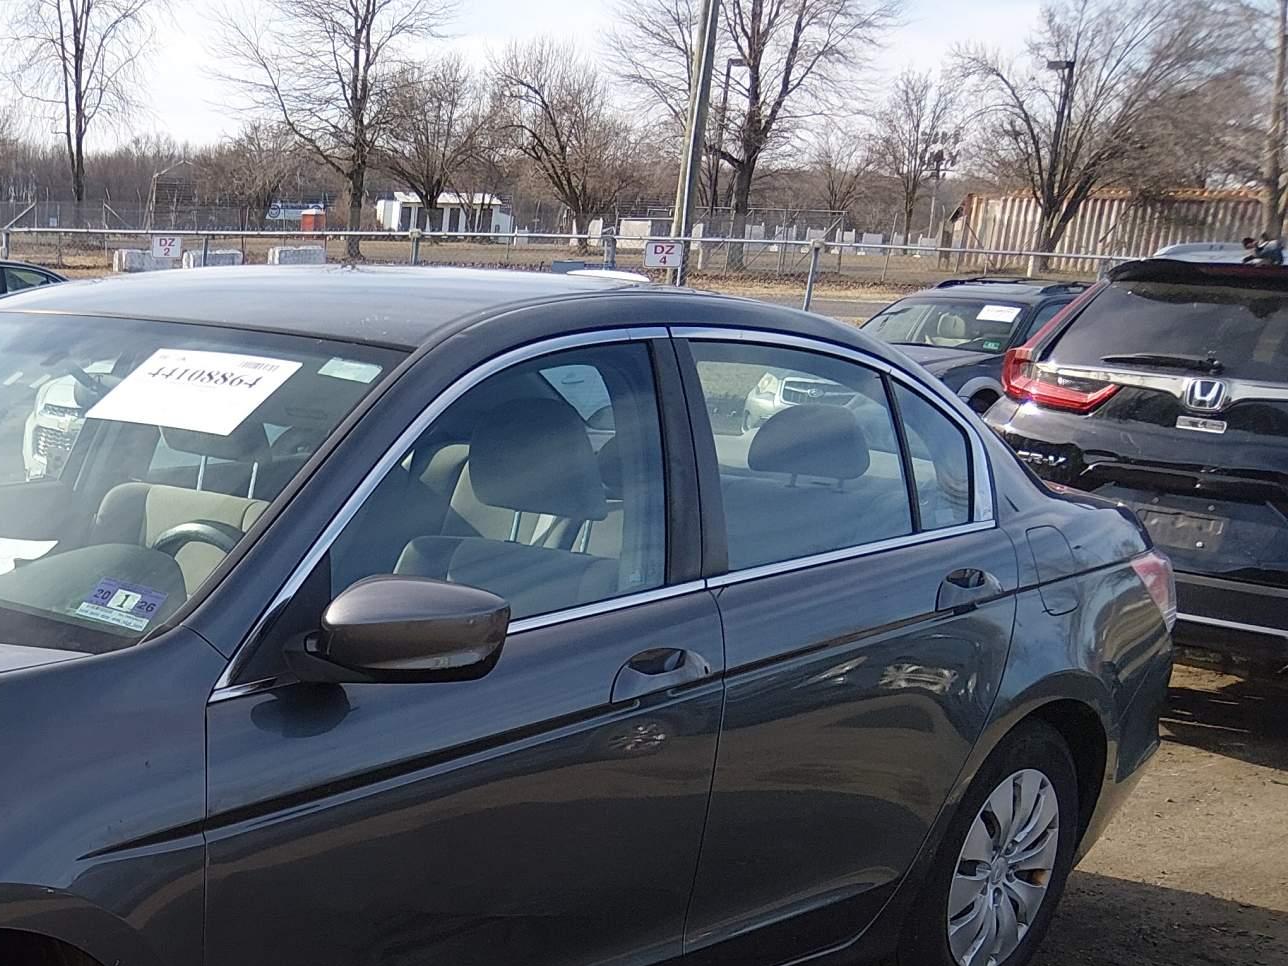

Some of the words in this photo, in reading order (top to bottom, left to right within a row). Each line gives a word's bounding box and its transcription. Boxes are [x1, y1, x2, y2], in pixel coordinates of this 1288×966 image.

[159, 238, 176, 247] DZ
[163, 247, 171, 257] 2
[653, 244, 675, 255] DZ
[659, 255, 667, 265] 4
[147, 366, 263, 389] 44108864
[93, 588, 112, 600] 20
[136, 600, 157, 613] 26
